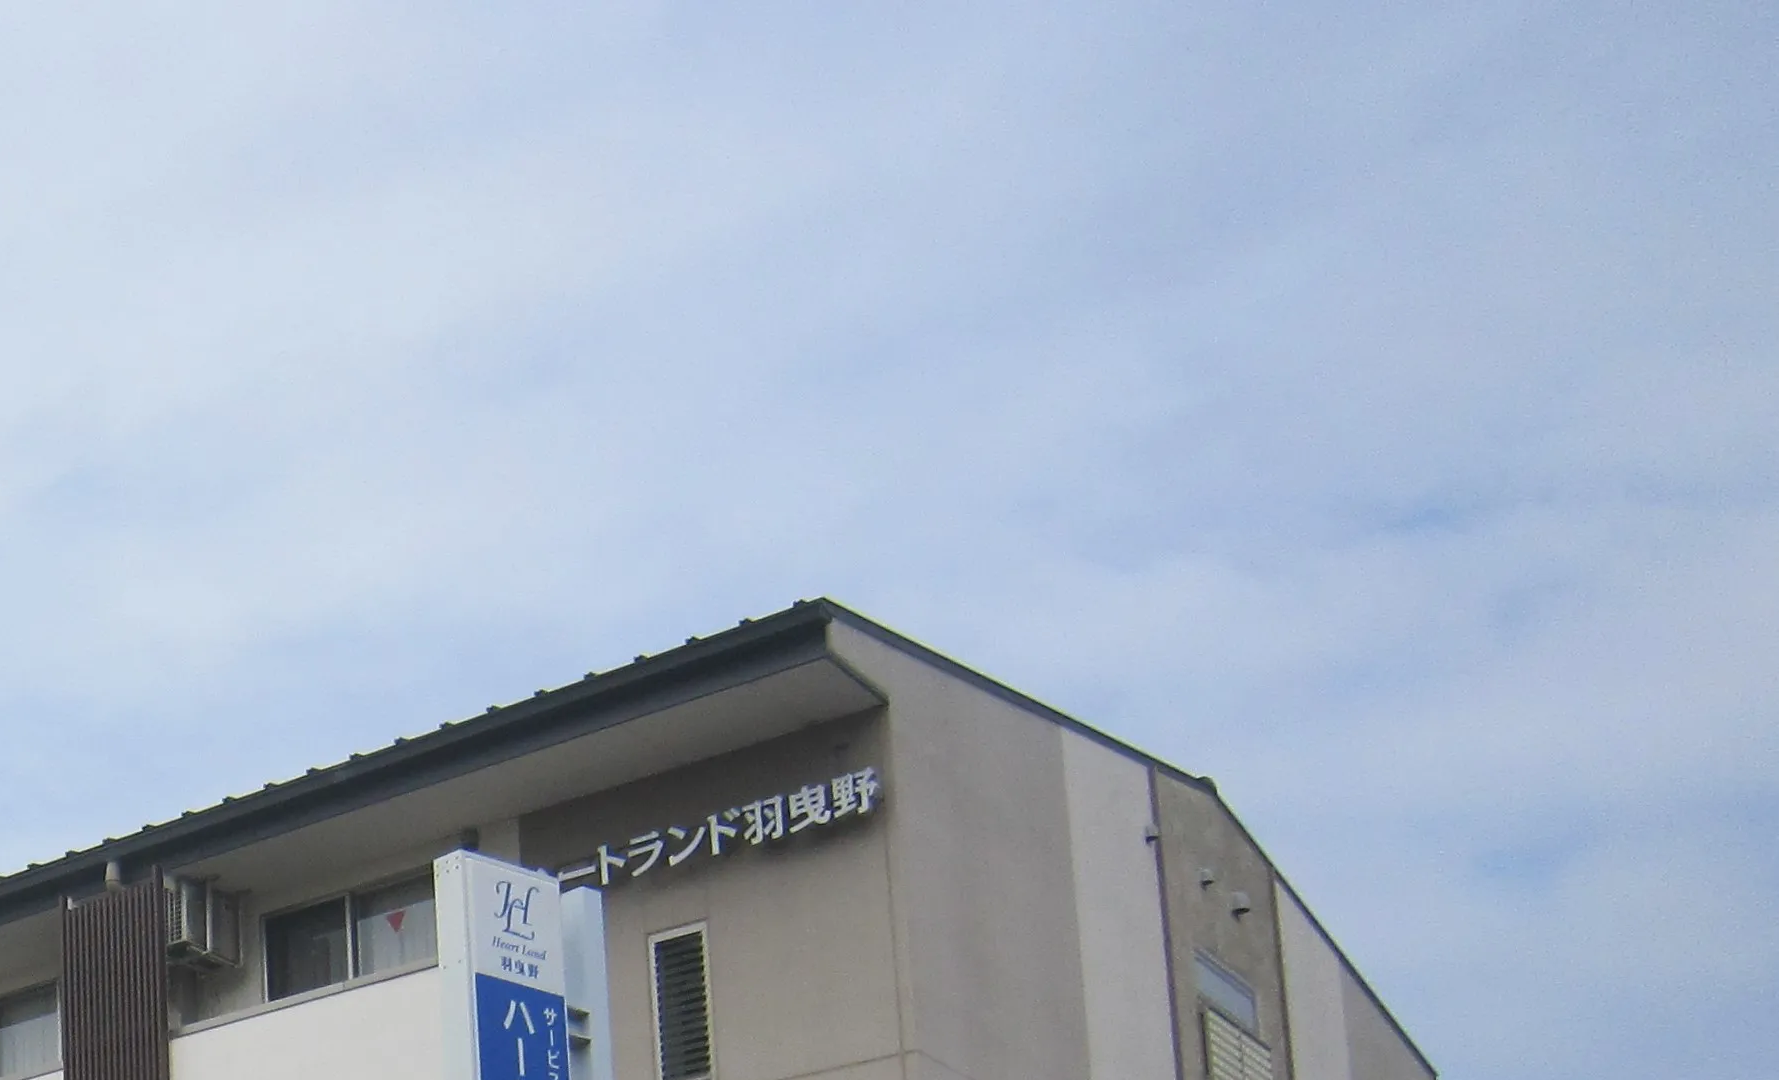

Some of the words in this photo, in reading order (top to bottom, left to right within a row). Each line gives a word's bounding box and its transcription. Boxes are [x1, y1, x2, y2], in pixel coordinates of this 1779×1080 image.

[557, 766, 881, 886] ートランド羽曳野
[491, 936, 519, 953] Heart
[521, 945, 547, 961] Land
[500, 956, 539, 979] 羽曳野
